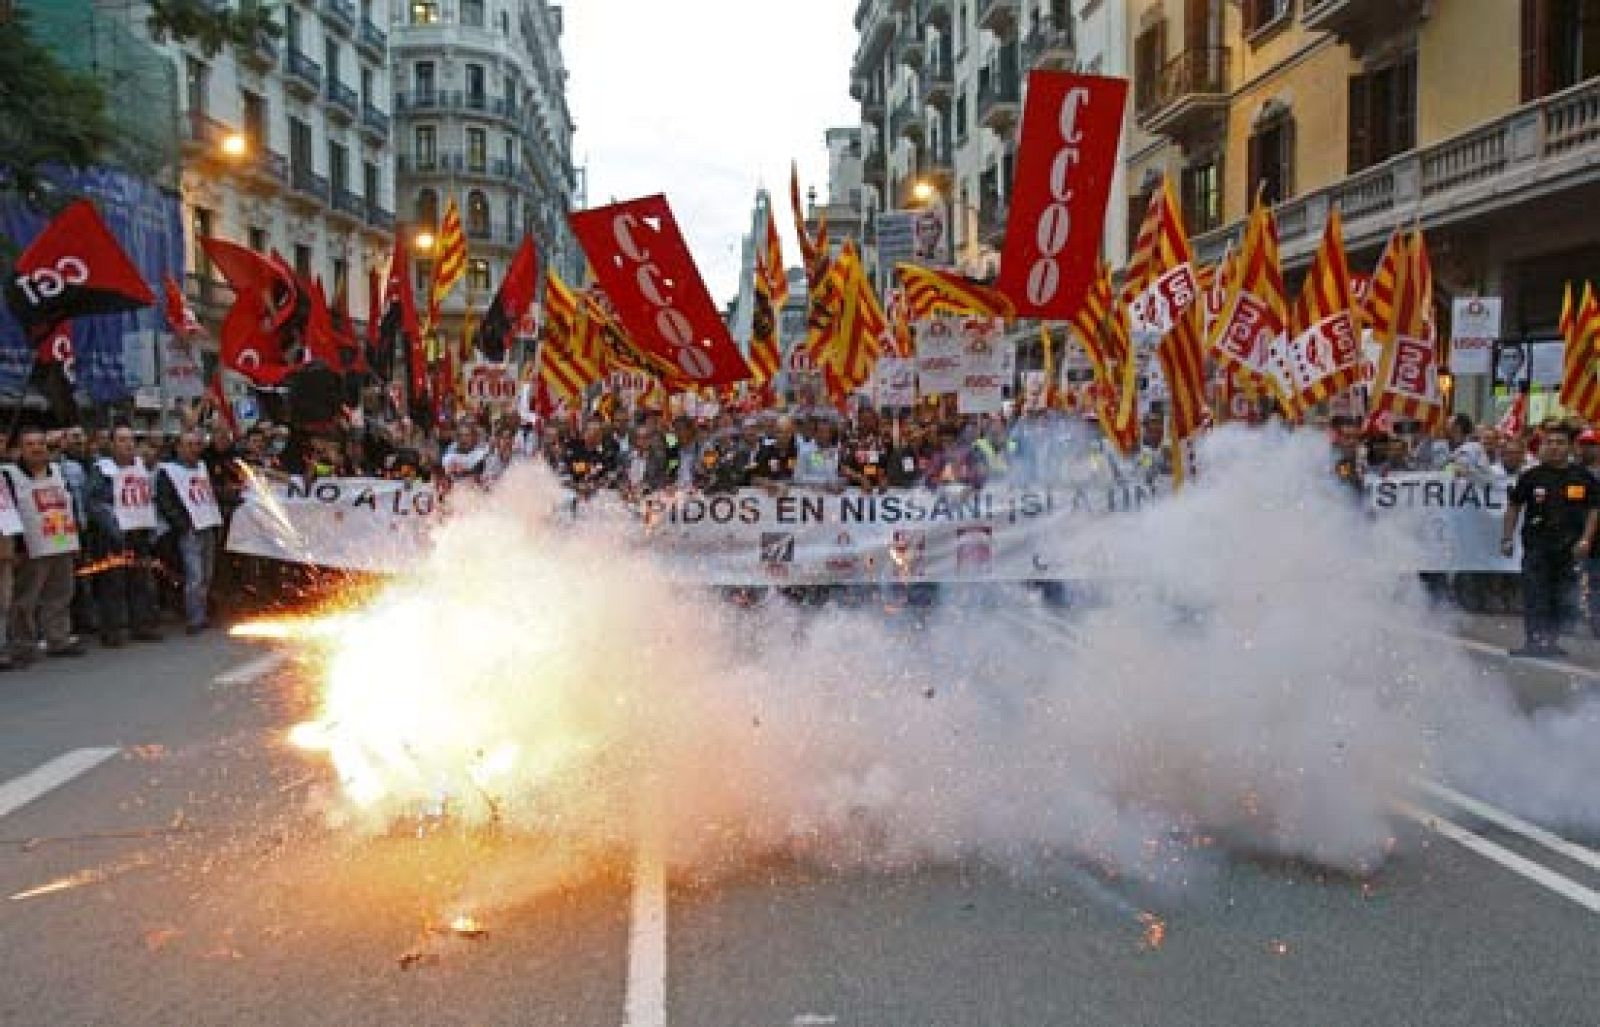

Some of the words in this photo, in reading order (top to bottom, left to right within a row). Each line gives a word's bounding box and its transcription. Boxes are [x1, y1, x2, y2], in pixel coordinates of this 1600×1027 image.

[1028, 86, 1092, 307] CCOO
[612, 212, 714, 379] CCOO
[288, 481, 340, 501] NO
[353, 487, 377, 510] A
[391, 488, 434, 516] LO
[645, 496, 761, 523] PIDOS
[776, 496, 824, 523] EN
[1376, 480, 1503, 508] STRIAL
